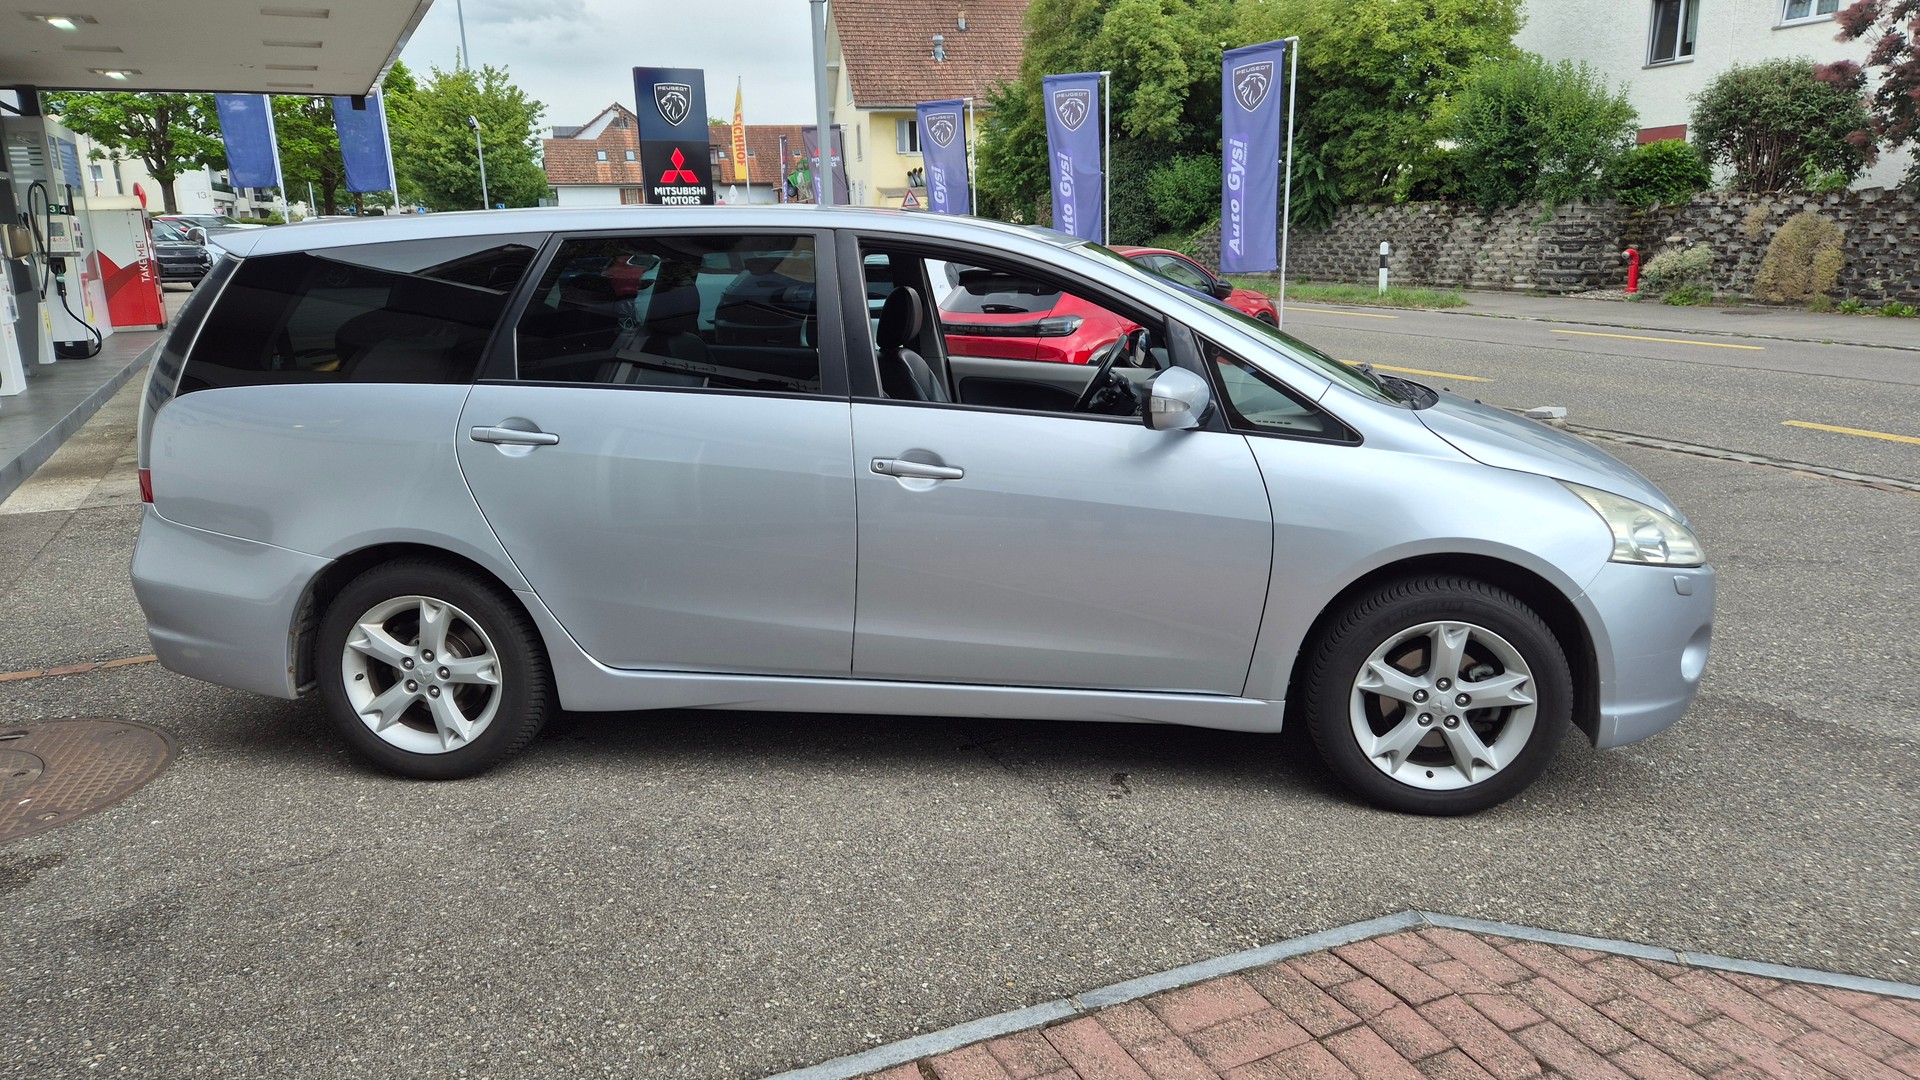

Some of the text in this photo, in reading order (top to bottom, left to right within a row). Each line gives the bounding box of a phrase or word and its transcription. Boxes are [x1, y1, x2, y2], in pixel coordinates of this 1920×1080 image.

[1236, 64, 1270, 75] PEUGEOT
[654, 187, 706, 196] MITSUBISHI
[662, 196, 701, 205] MOTORS
[931, 165, 947, 204] Gysi
[1058, 152, 1074, 236] uto Gysi
[1228, 138, 1246, 255] Auto Gysi
[136, 240, 151, 283] TAKE ME!
